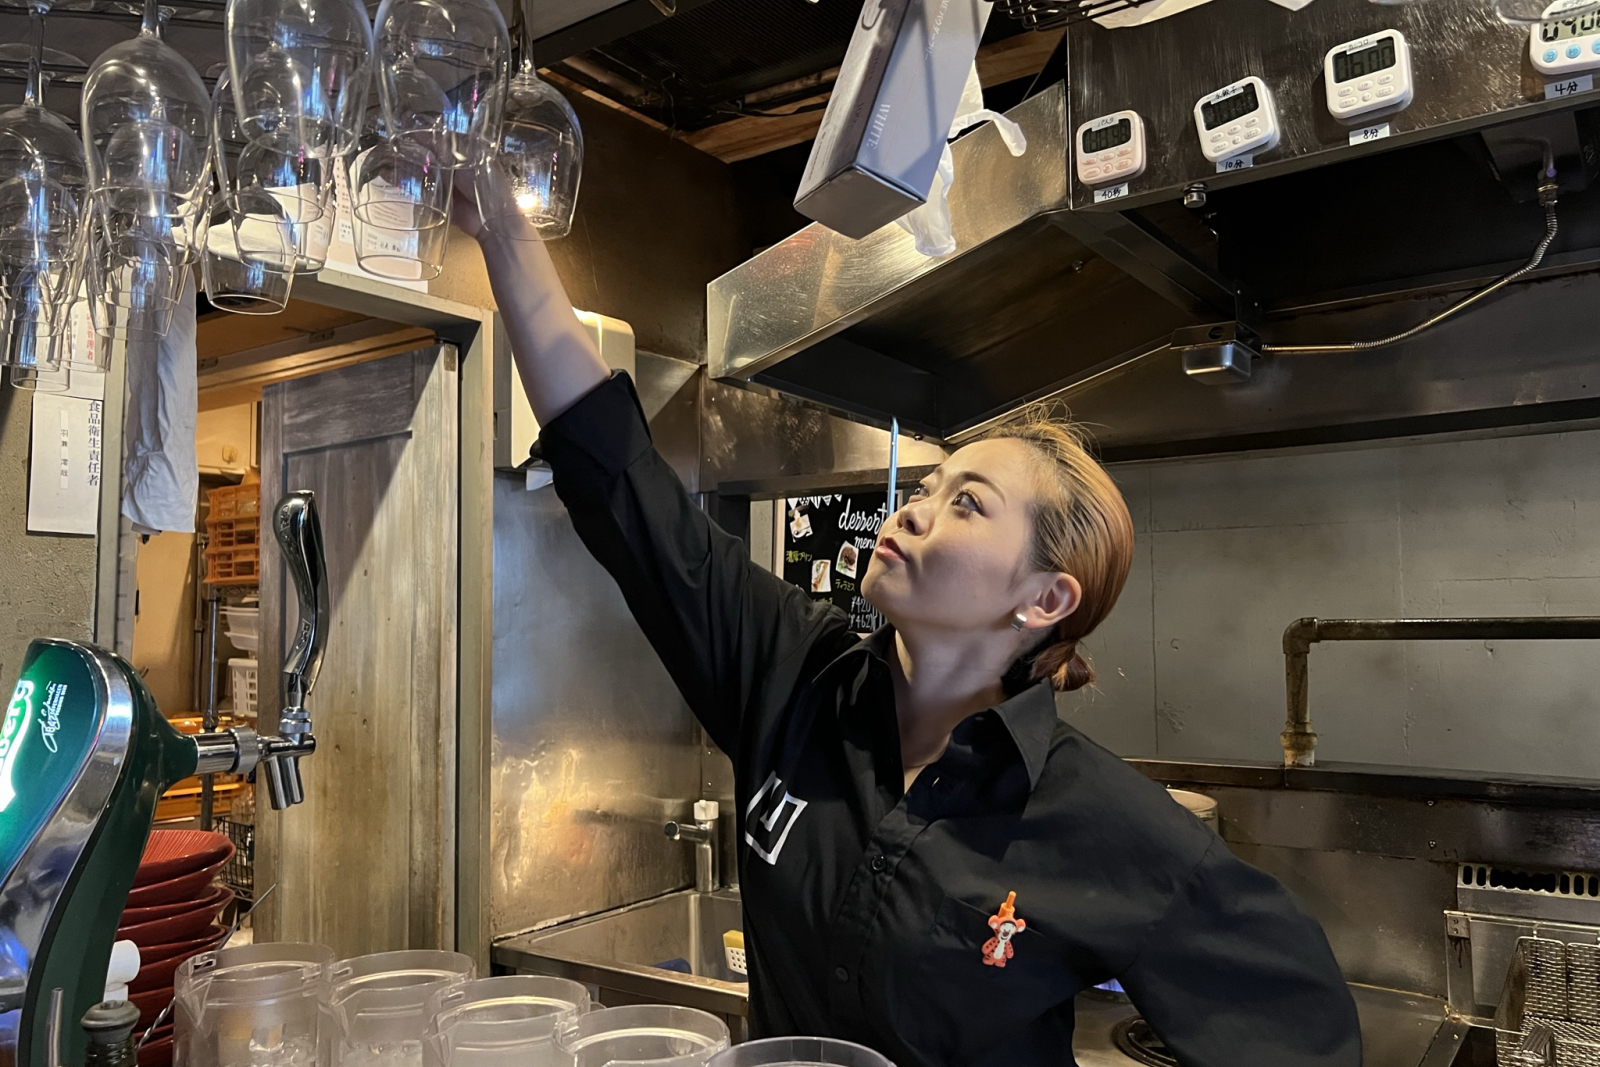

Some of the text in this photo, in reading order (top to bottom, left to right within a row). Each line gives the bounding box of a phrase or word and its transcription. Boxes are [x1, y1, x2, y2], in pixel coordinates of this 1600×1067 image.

[1555, 81, 1578, 95] 4分
[866, 104, 891, 149] WHITE
[1363, 128, 1379, 140] 8分
[1224, 159, 1244, 170] 10分
[1101, 188, 1122, 199] 40秒
[87, 400, 101, 486] 食品衛生責任者
[838, 497, 887, 535] dessert
[854, 536, 876, 550] menu
[835, 578, 856, 592] ティラミス
